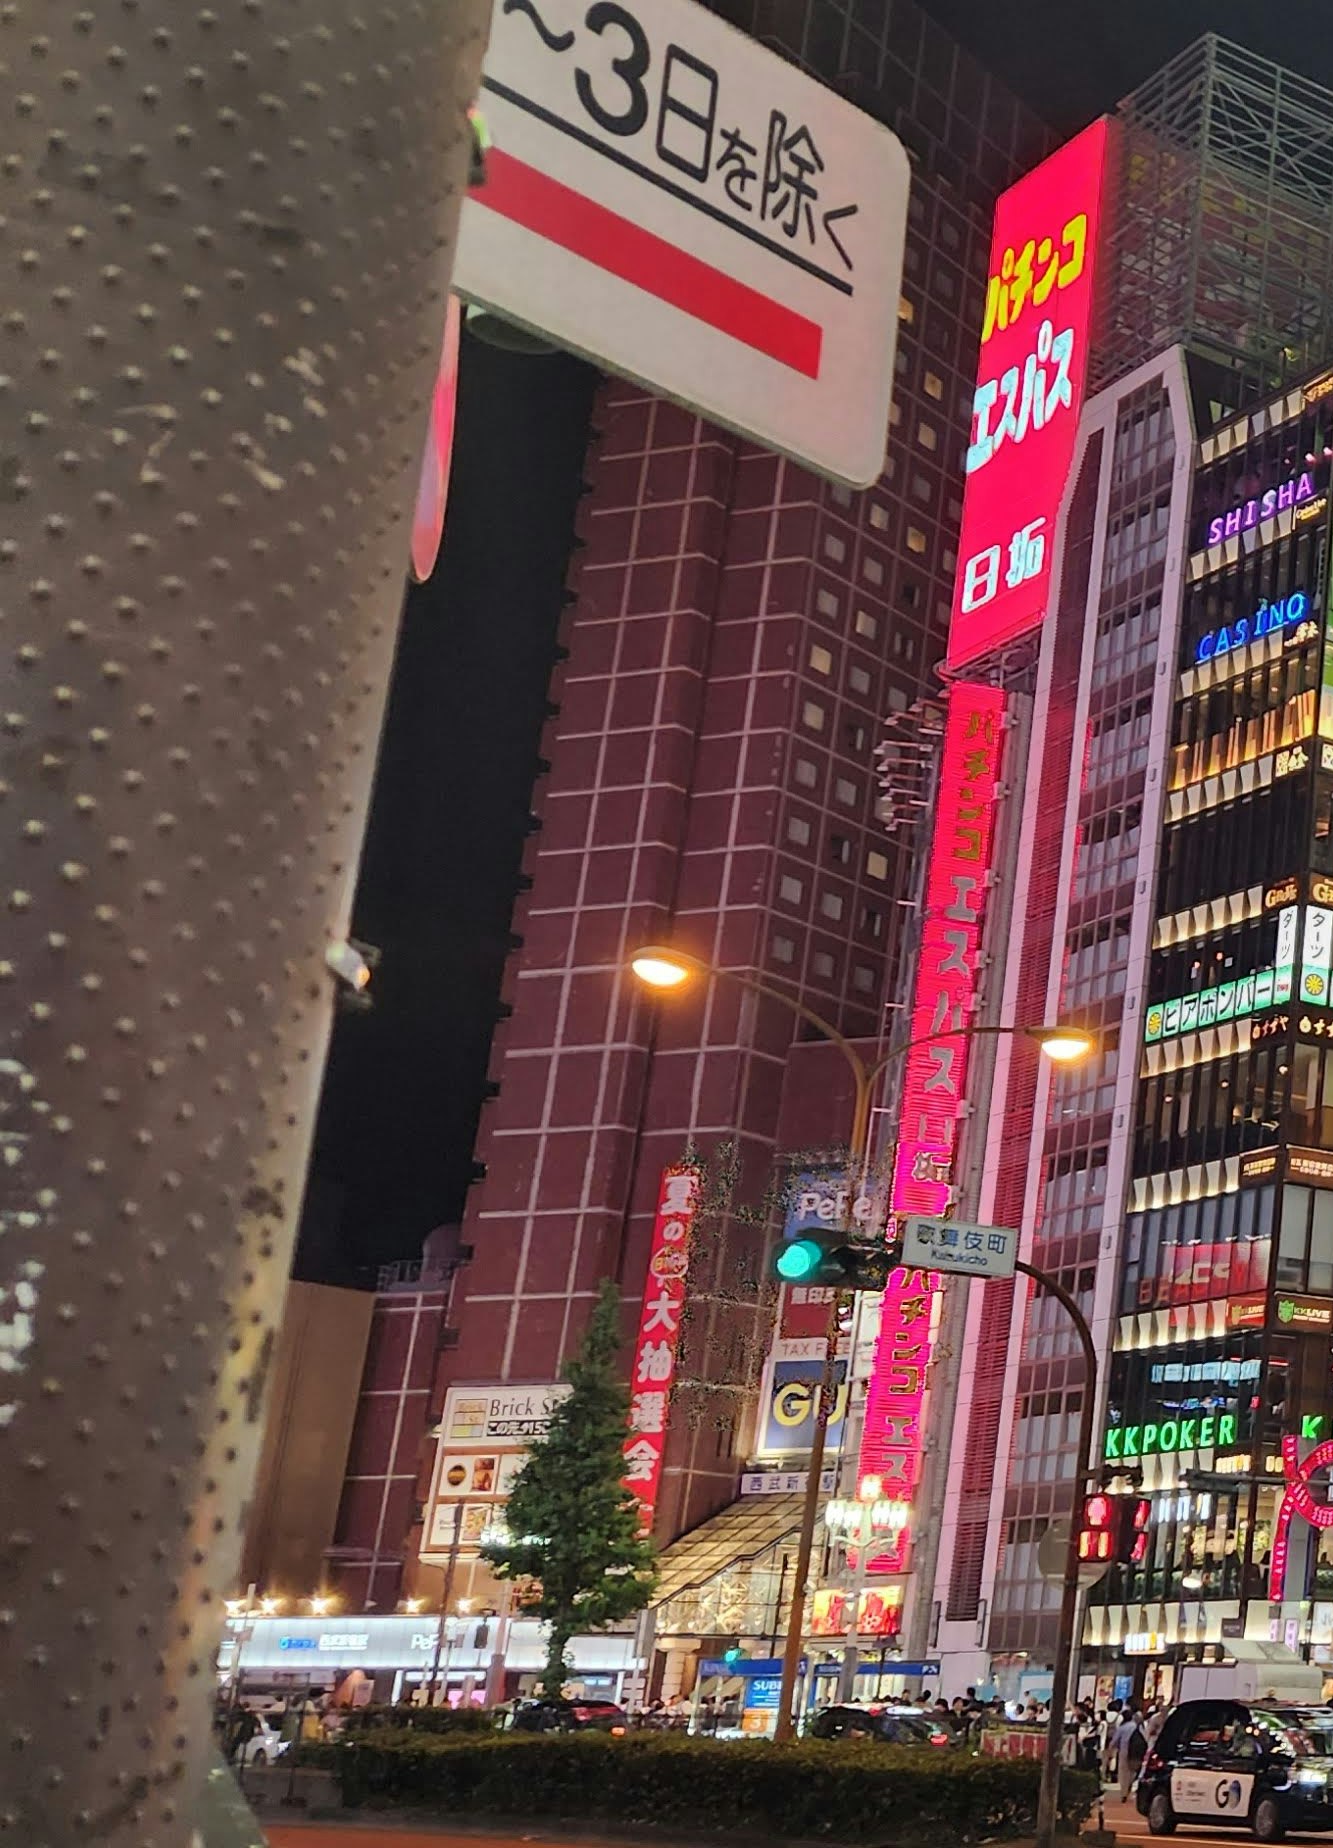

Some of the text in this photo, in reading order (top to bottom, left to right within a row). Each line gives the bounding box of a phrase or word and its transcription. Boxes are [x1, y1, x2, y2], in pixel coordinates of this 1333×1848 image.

[982, 213, 1087, 341] パチンコ
[967, 321, 1075, 472] エスパス
[1208, 473, 1312, 545] SHISHA
[1198, 591, 1308, 662] CASINO
[954, 708, 994, 861] パチンコ
[923, 875, 977, 1093] エスパス
[1163, 975, 1271, 1031] ビアポンバー
[661, 1176, 697, 1240] 夏の
[917, 1222, 1007, 1254] 歌舞伎町
[784, 1344, 811, 1357] TAX
[490, 1398, 533, 1417] Brick
[623, 1291, 680, 1481] 大抽選会
[773, 1383, 847, 1427] GU
[1106, 1415, 1234, 1458] KKPOKER
[1215, 1779, 1241, 1808] GO
